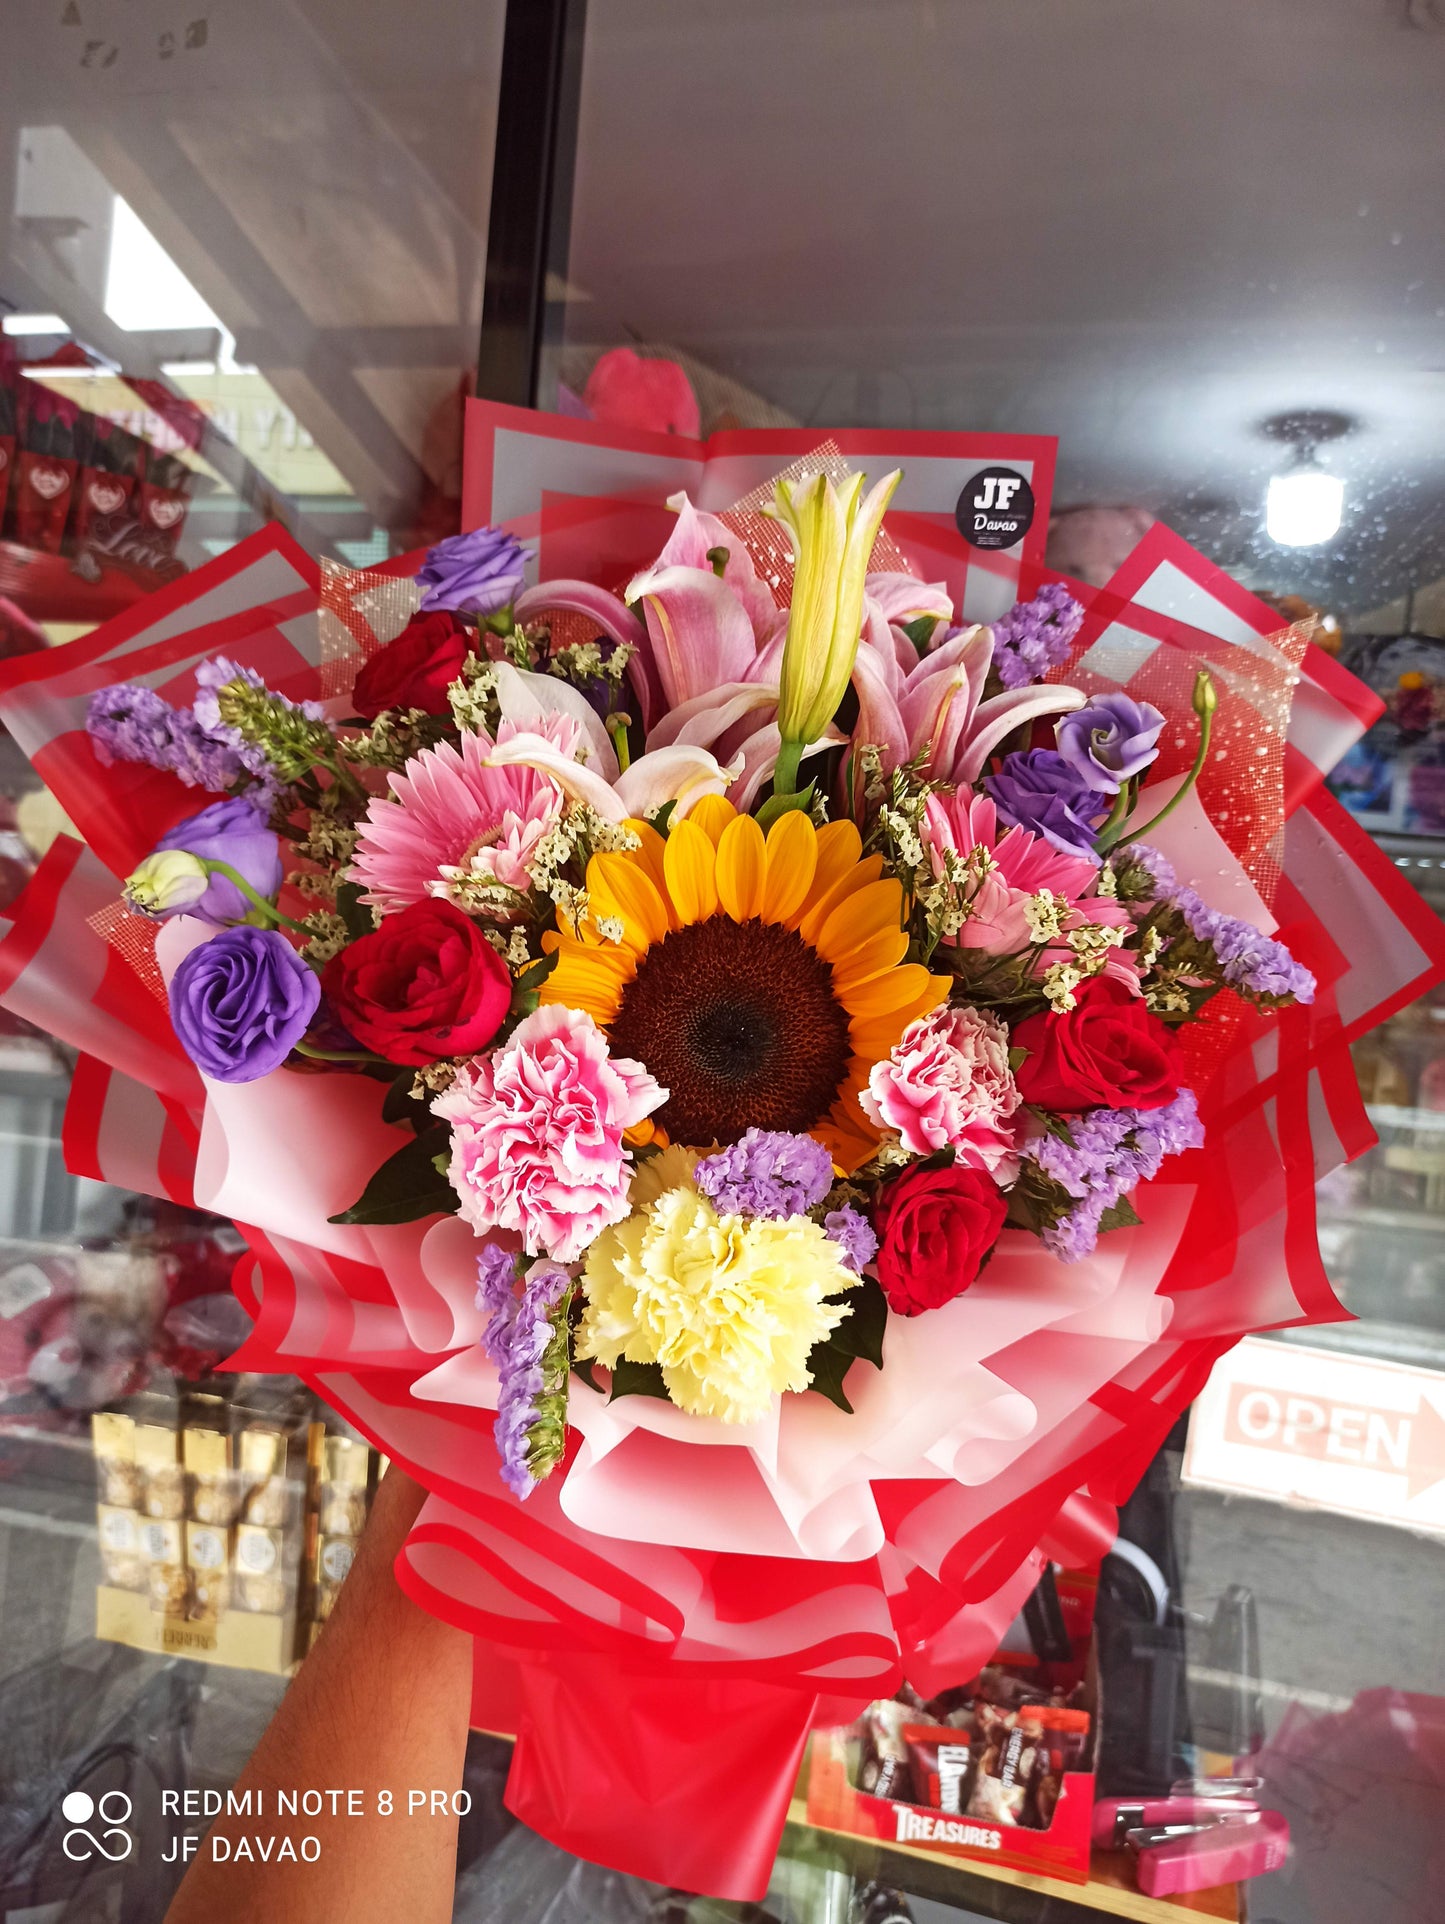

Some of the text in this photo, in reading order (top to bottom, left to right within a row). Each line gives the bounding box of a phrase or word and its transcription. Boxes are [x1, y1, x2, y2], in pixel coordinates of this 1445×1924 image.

[973, 477, 1021, 510] JF
[974, 513, 1018, 532] Davao
[1237, 1391, 1412, 1469] OPEN
[892, 1804, 1002, 1850] TREASURES
